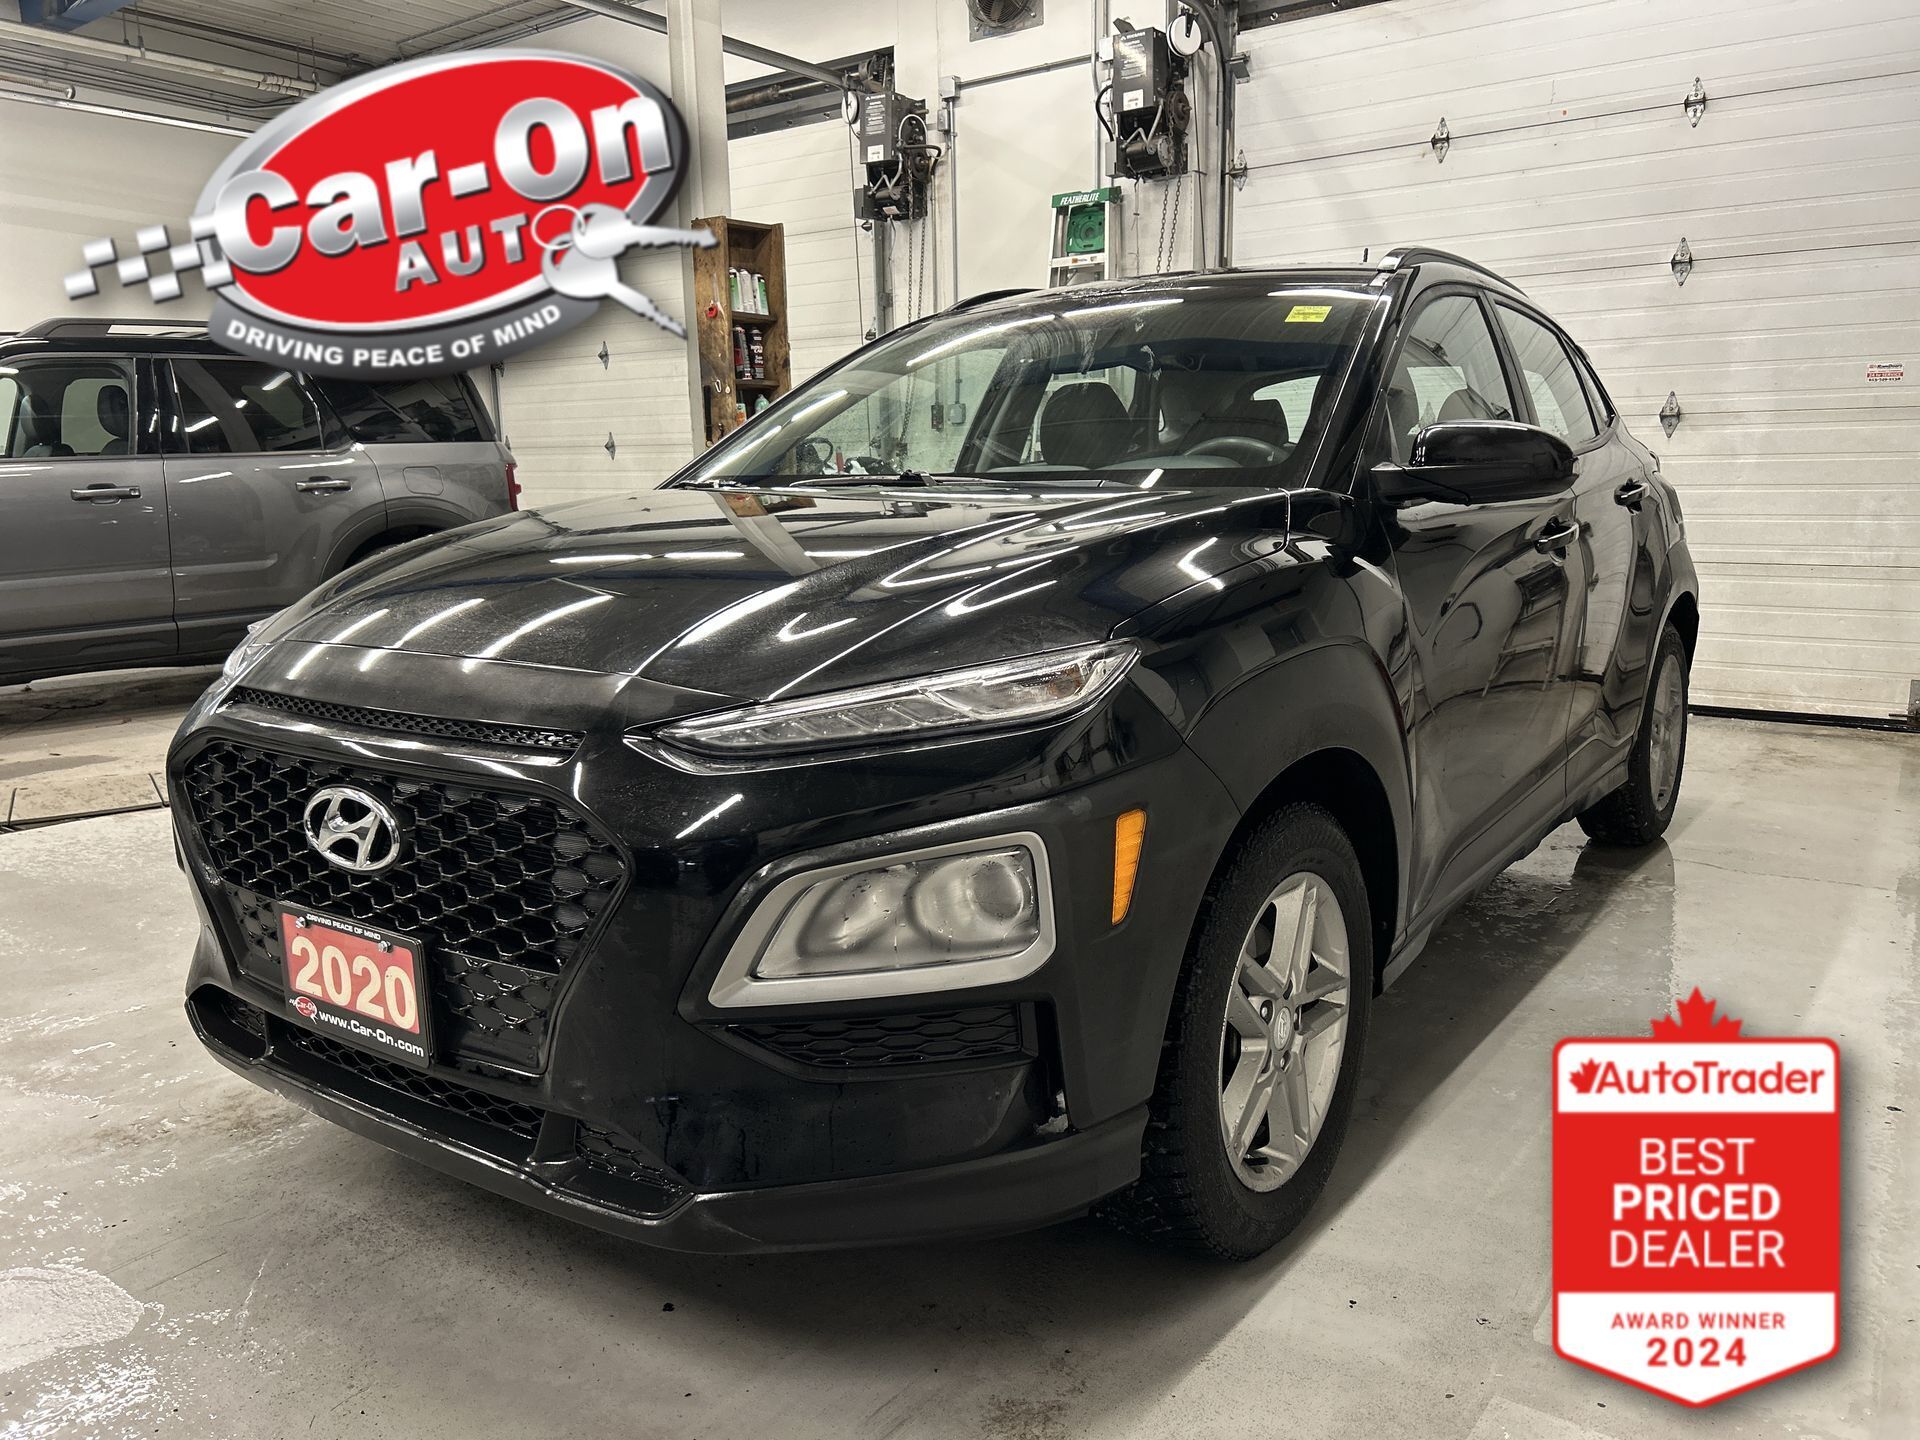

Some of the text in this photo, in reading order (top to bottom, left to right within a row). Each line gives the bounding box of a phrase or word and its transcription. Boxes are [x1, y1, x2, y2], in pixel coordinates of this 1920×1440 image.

[1060, 192, 1100, 205] FEATHERLITE
[306, 913, 381, 940] DRIVING PEACE OF MIND
[291, 936, 417, 1030] 2020
[319, 1011, 424, 1057] www.Car-On.com
